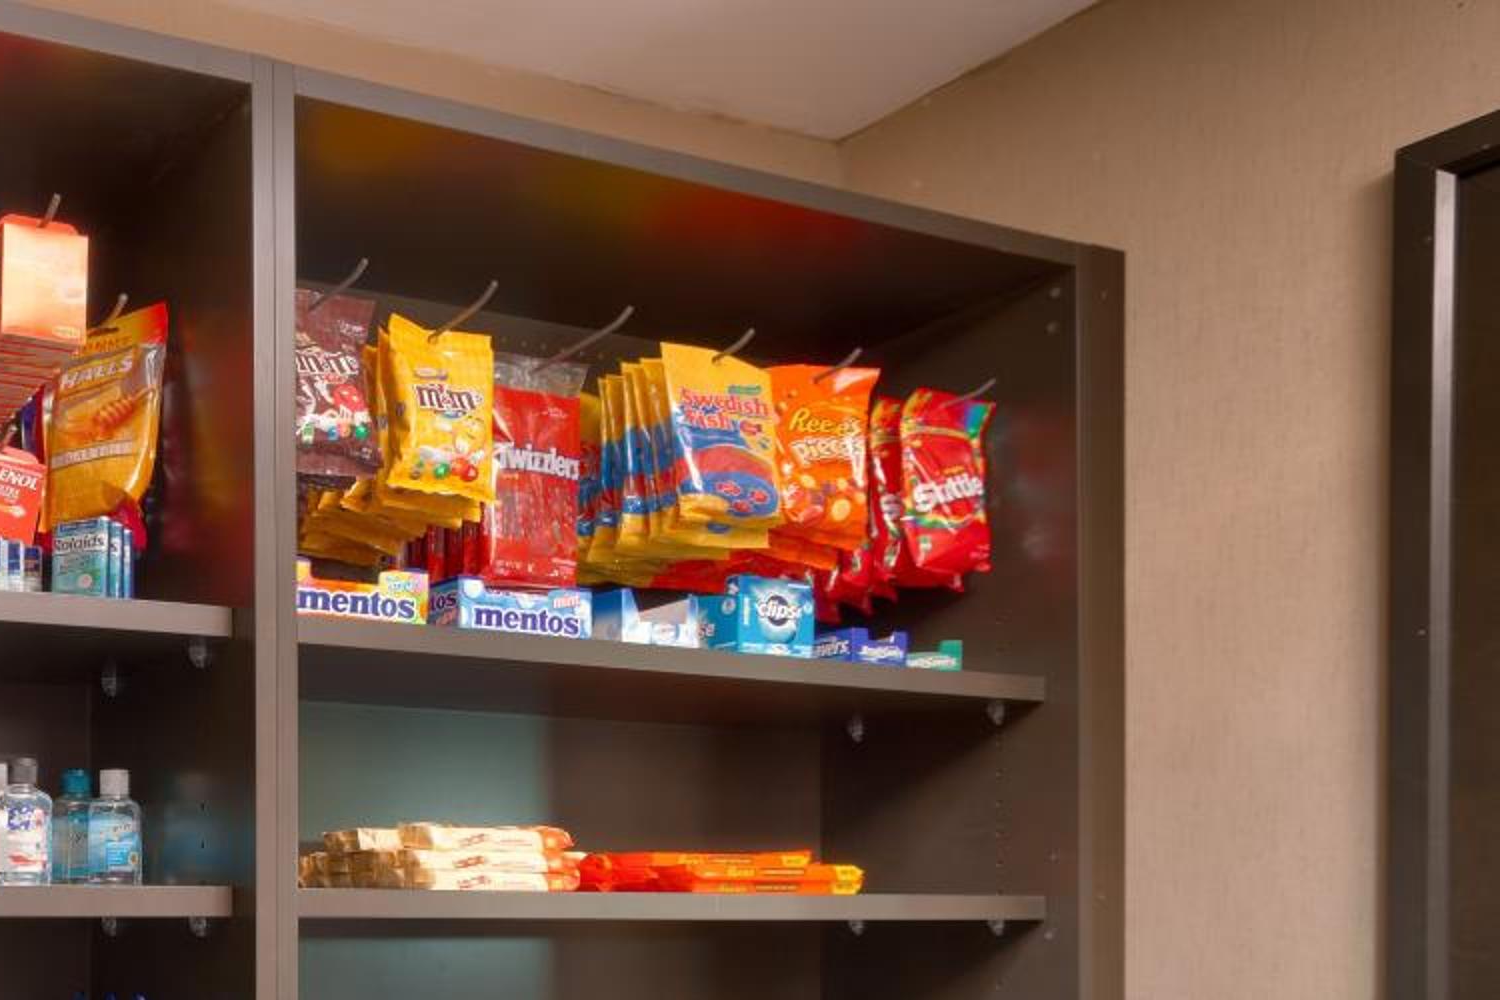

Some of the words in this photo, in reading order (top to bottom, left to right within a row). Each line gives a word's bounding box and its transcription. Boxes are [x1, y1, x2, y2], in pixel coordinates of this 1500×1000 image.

[681, 387, 770, 418] Swedish
[298, 588, 415, 619] mentos
[474, 605, 579, 636] mentos
